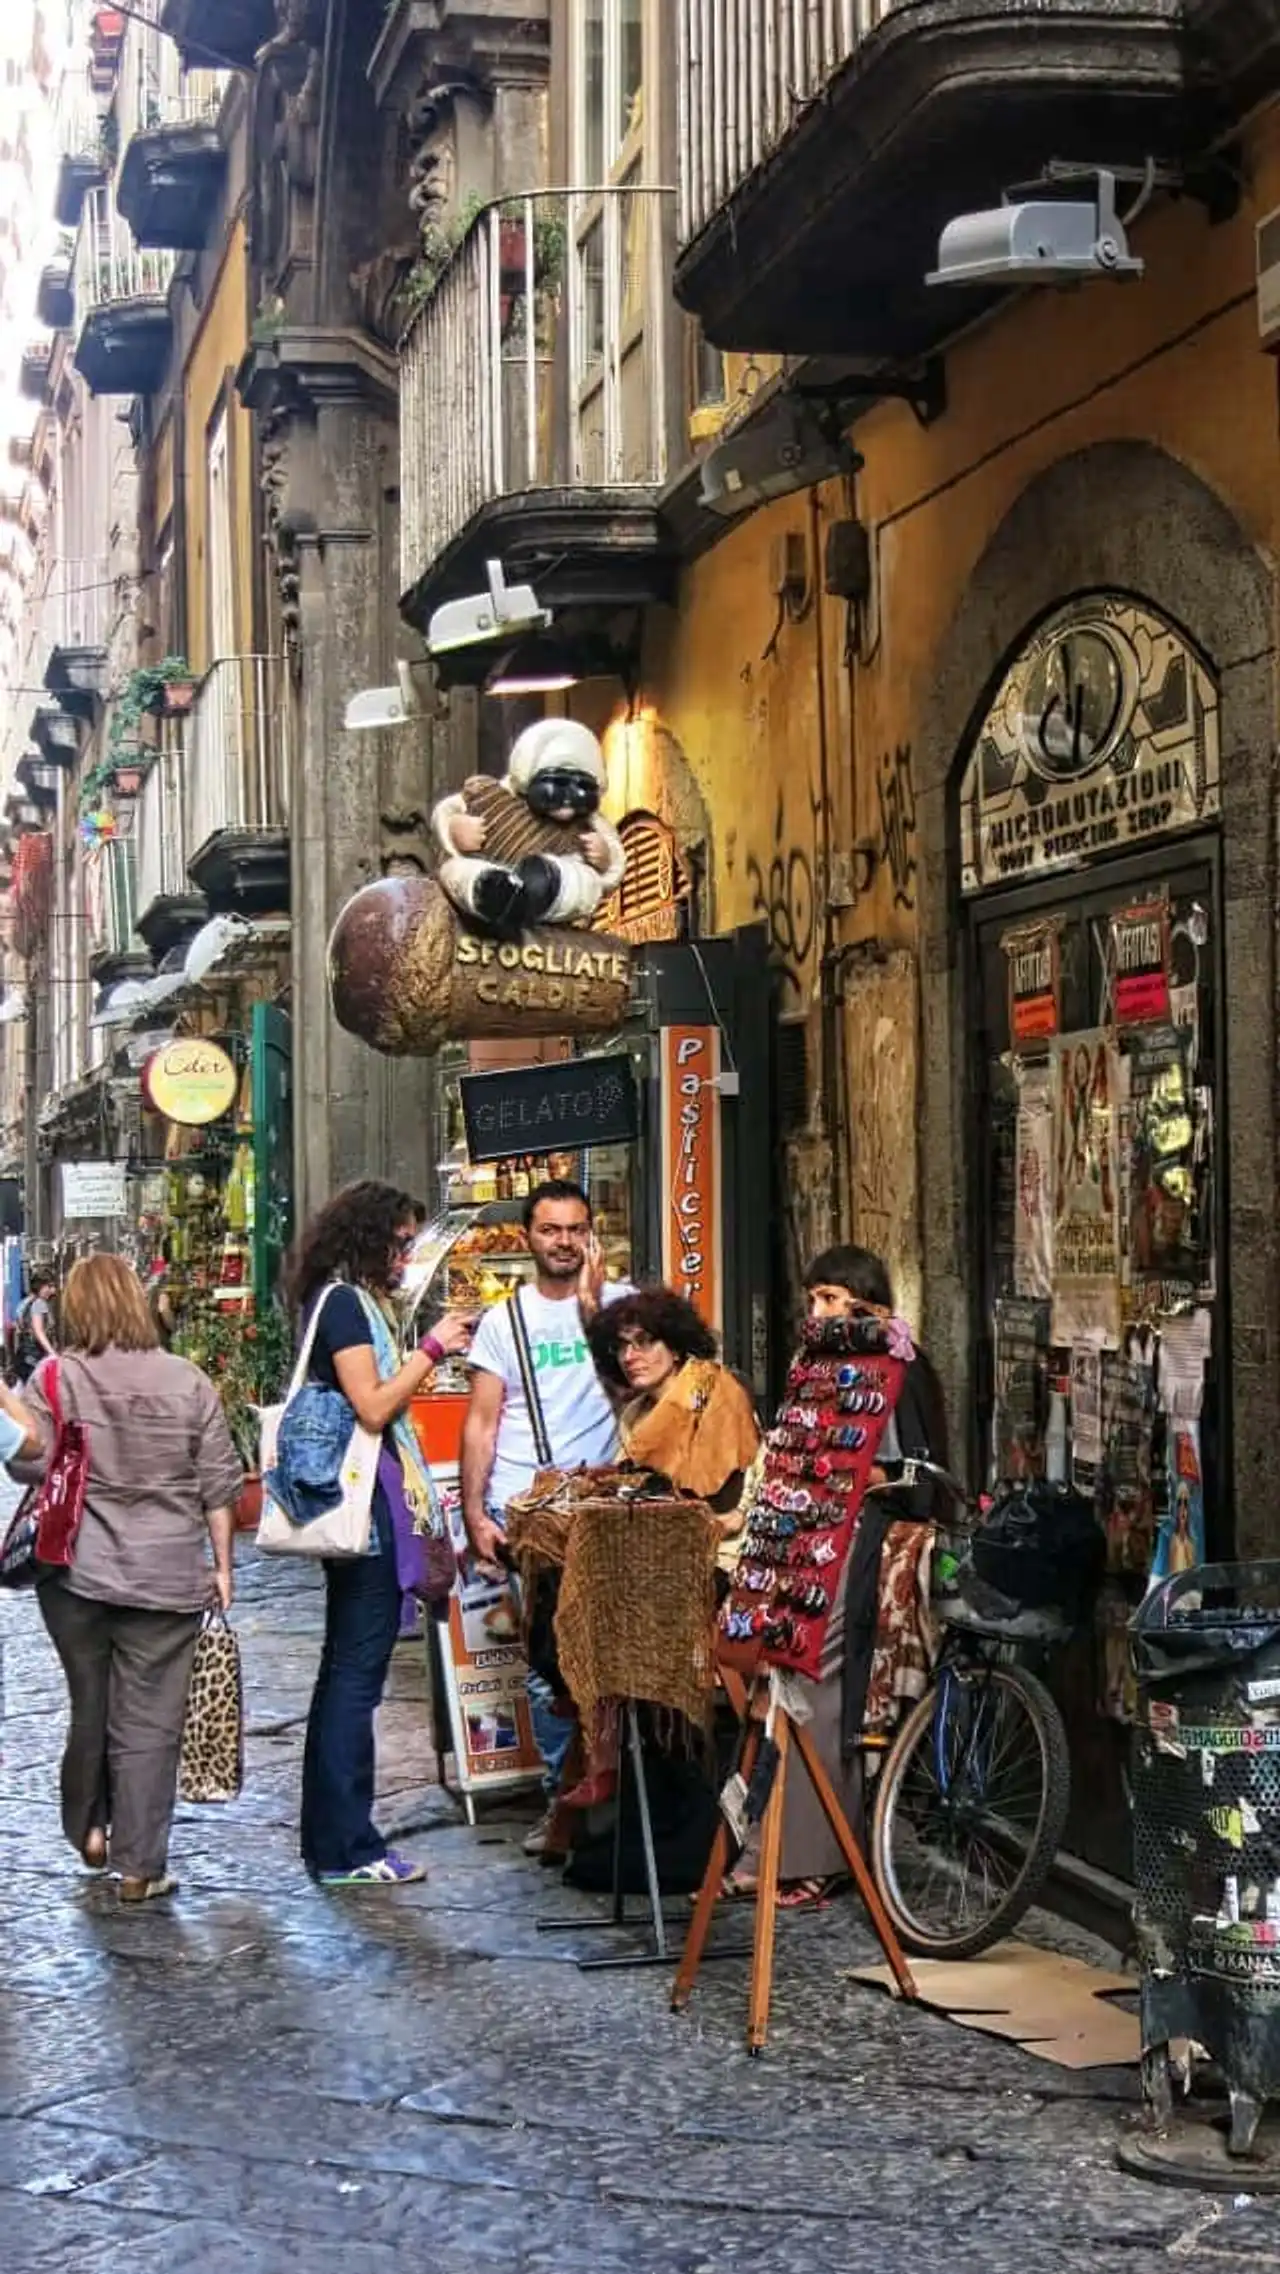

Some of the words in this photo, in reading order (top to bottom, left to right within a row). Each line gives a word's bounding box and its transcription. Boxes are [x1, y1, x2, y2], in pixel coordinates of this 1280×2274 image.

[989, 758, 1179, 849] MICROMUTAZIONI
[456, 935, 630, 983] SFOGLIATE
[477, 975, 601, 1014] CALDE
[472, 1089, 592, 1132] GELATO
